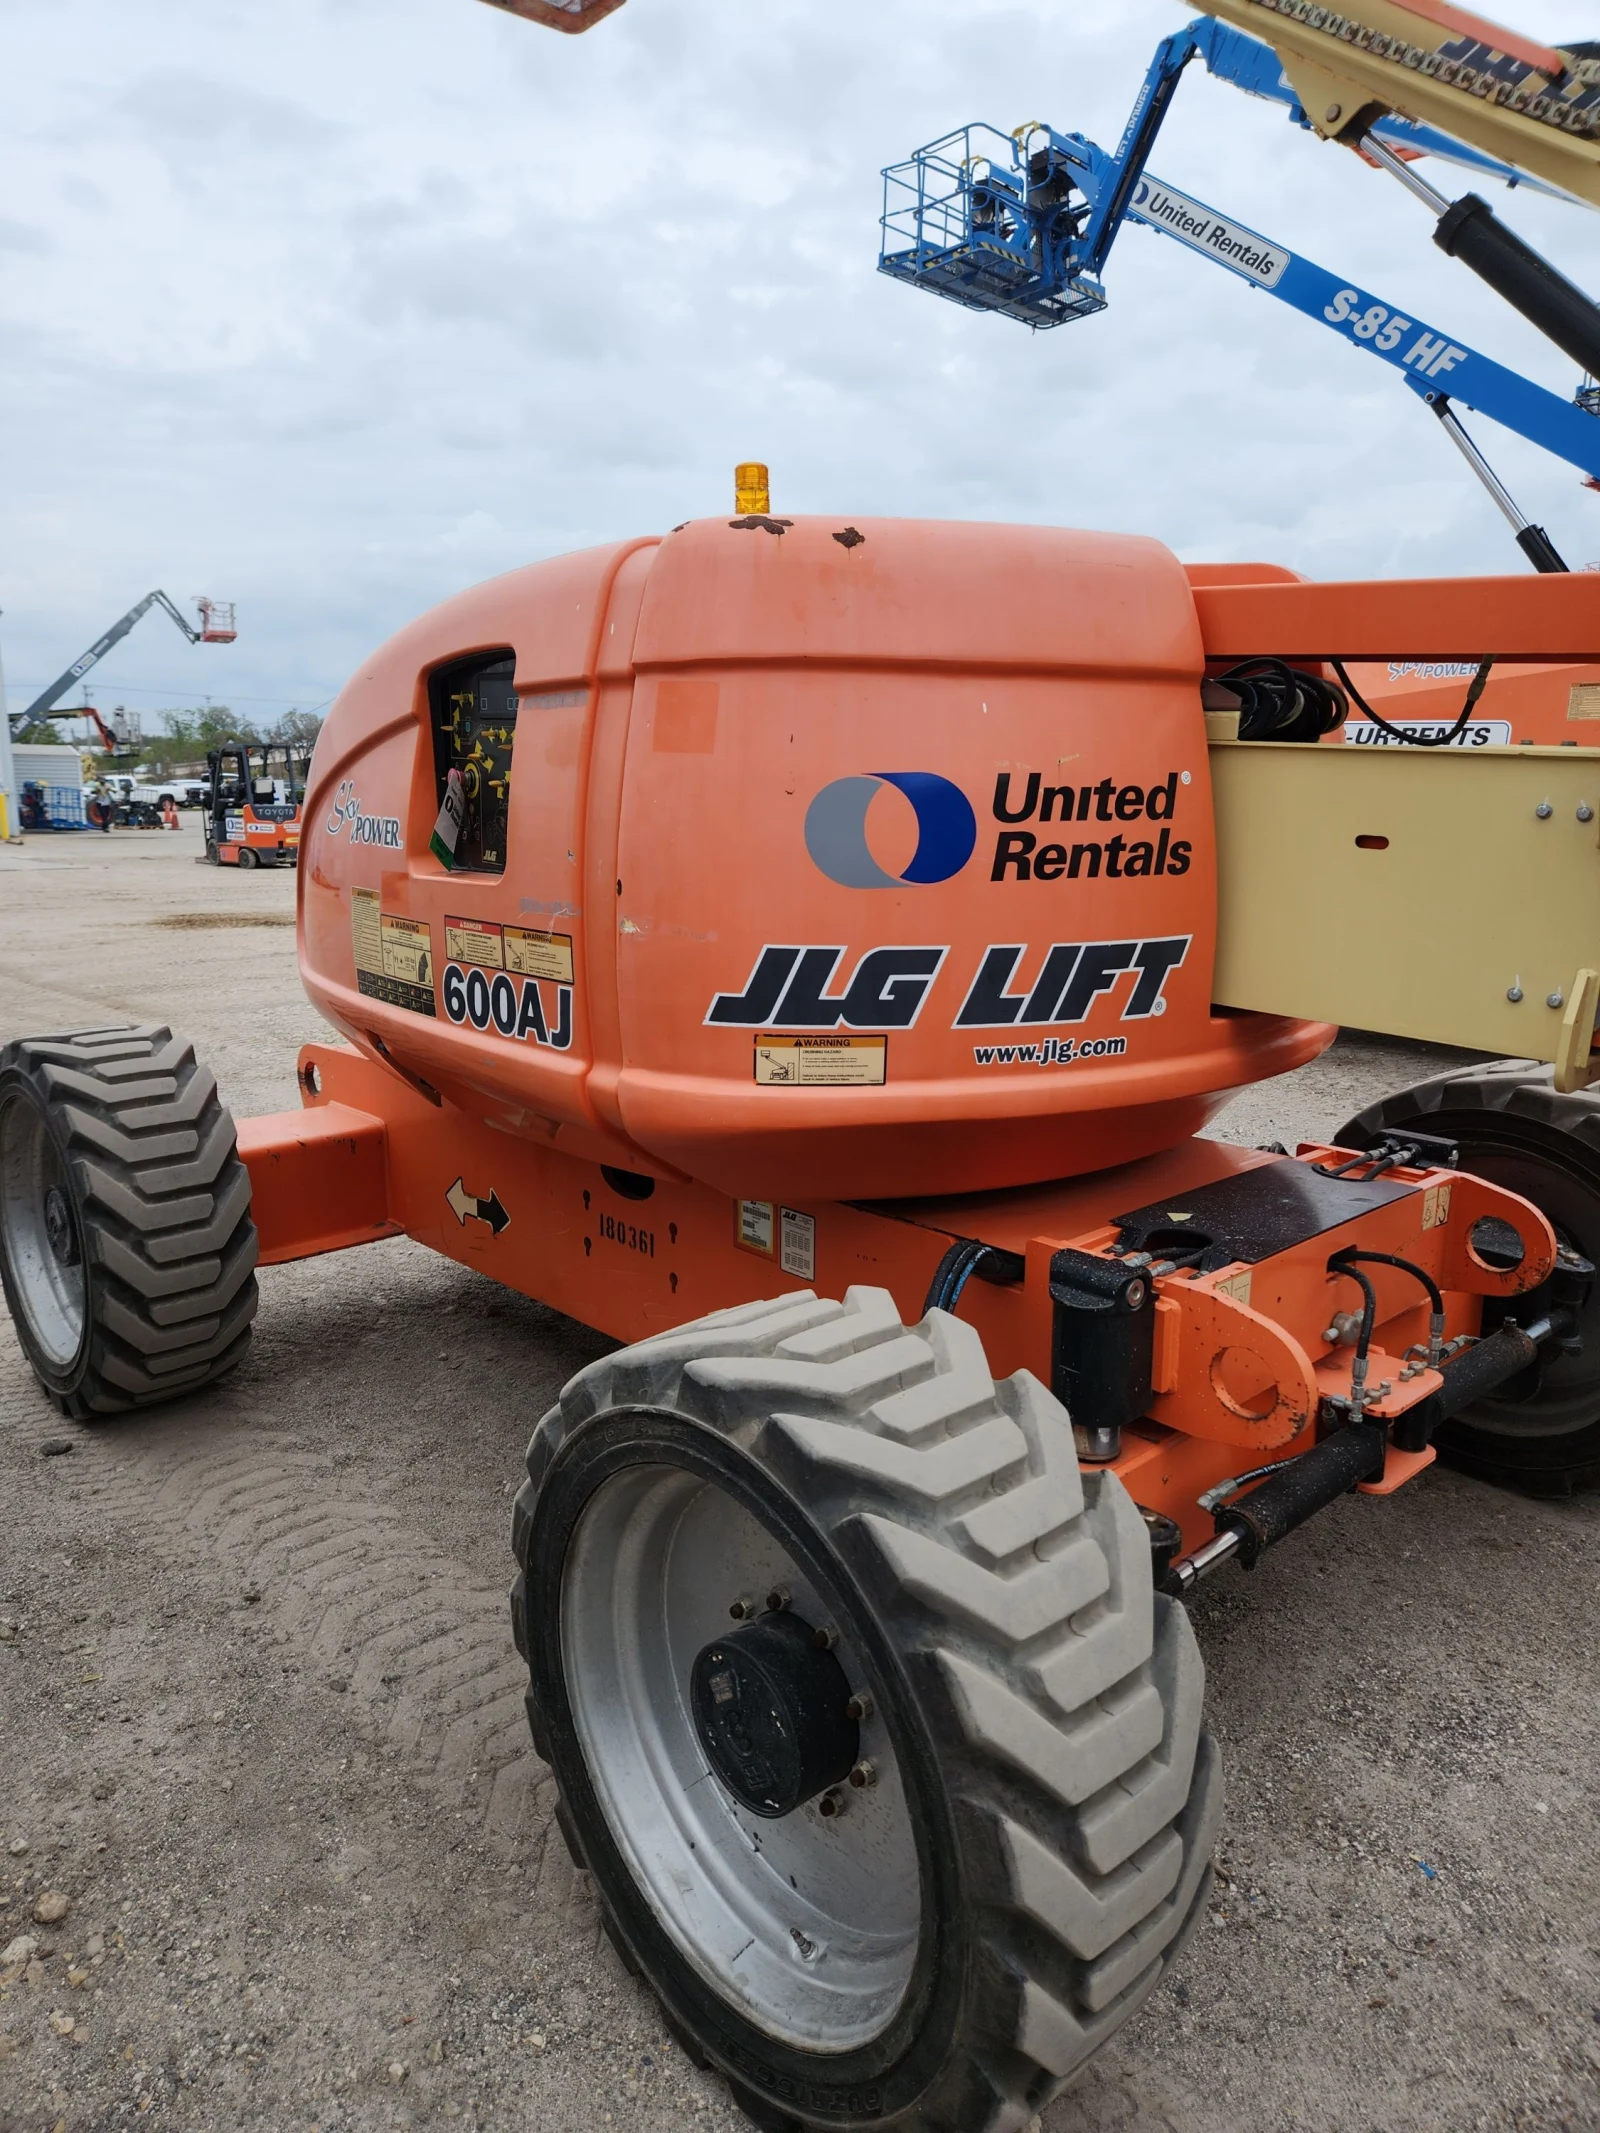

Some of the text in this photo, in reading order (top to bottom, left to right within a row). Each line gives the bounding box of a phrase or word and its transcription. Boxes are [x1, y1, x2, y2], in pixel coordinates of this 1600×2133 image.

[1148, 192, 1275, 276] United Rentals
[1323, 290, 1468, 377] S-85 HF
[258, 808, 294, 816] TOYOTA
[991, 771, 1179, 824] United
[355, 814, 401, 848] POWER
[483, 849, 497, 861] JLG
[990, 828, 1192, 882] Rentals
[395, 920, 420, 933] WARNING
[702, 934, 1193, 1029] JLG LIFT
[443, 963, 572, 1051] 600AJ
[803, 1039, 850, 1047] WARNING
[973, 1036, 1127, 1066] www.jlg.com
[600, 1213, 654, 1258] 180361
